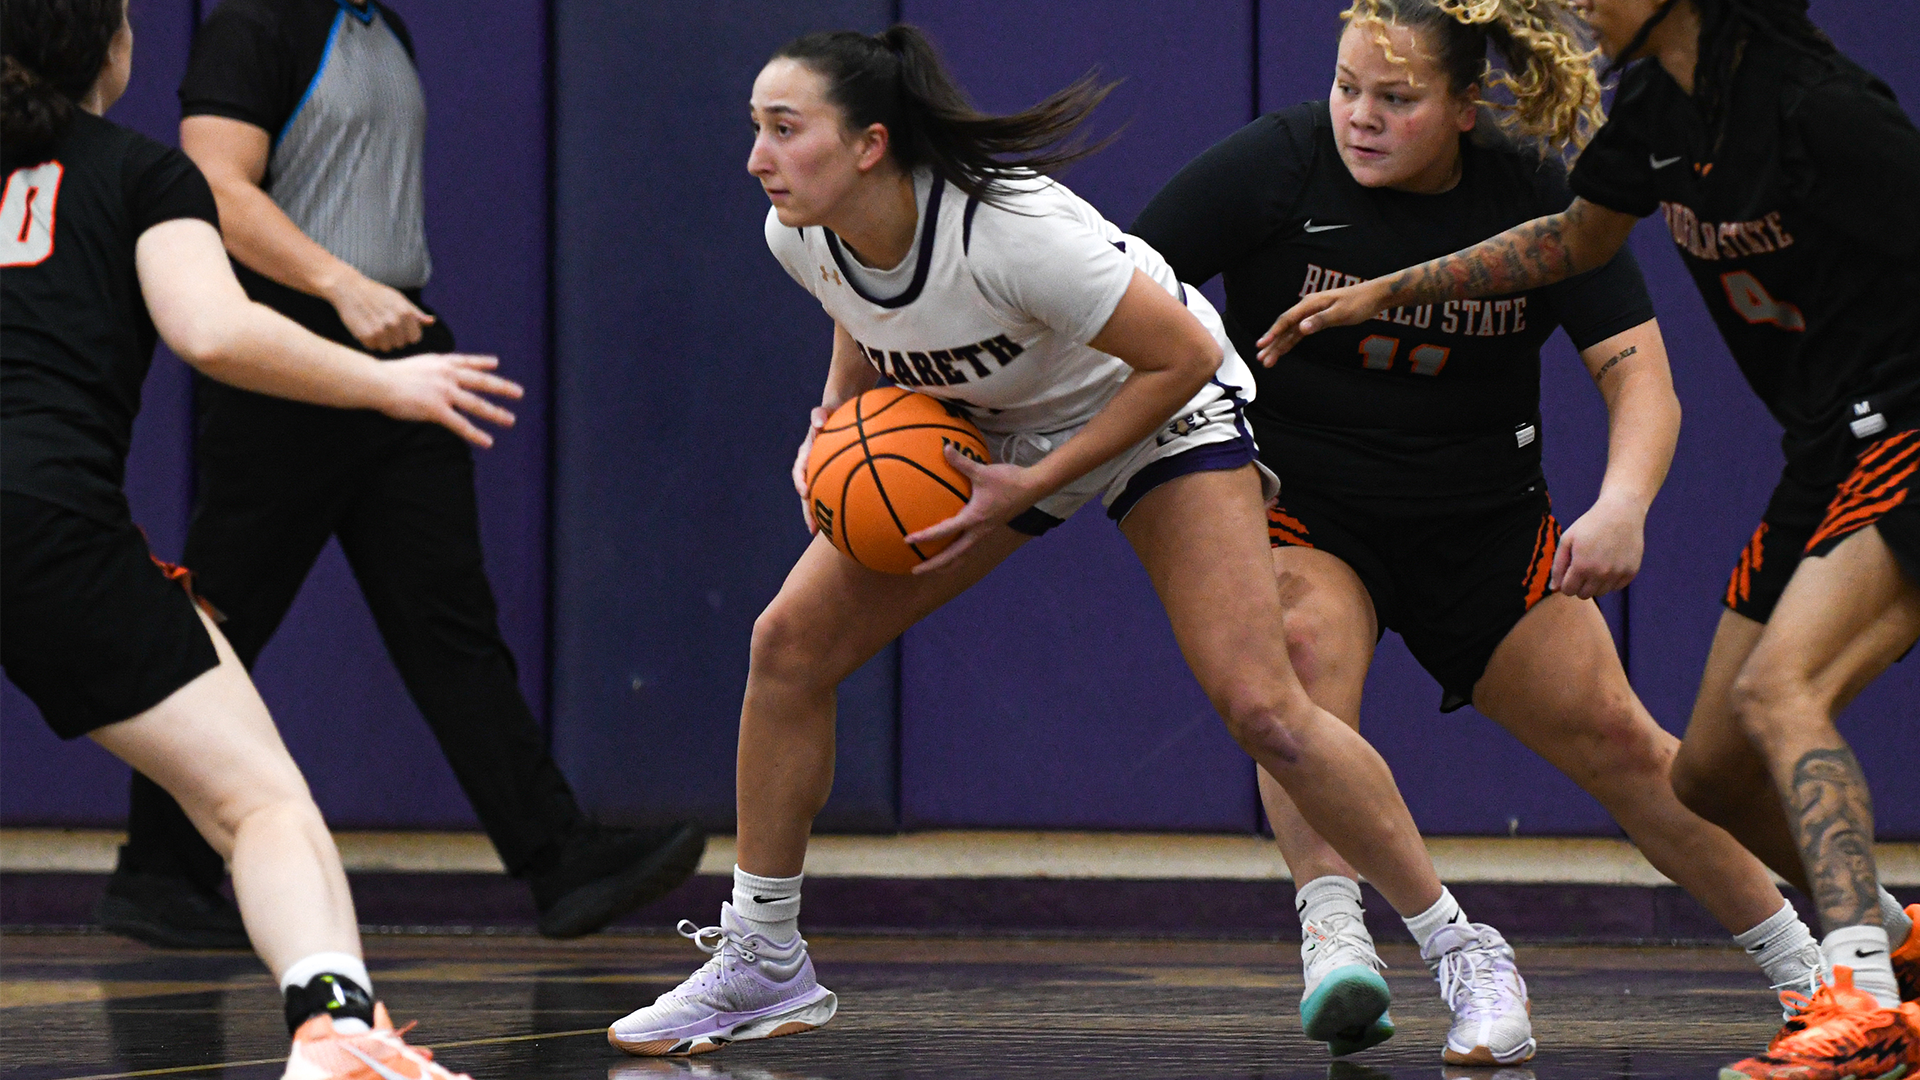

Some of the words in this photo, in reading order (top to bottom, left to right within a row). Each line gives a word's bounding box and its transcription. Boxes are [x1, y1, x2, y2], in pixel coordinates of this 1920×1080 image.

[1298, 263, 1433, 329] BULO
[1441, 296, 1527, 336] STATE
[1719, 269, 1806, 333] 4
[856, 333, 1025, 387] ZARETH
[1358, 334, 1450, 376] 11
